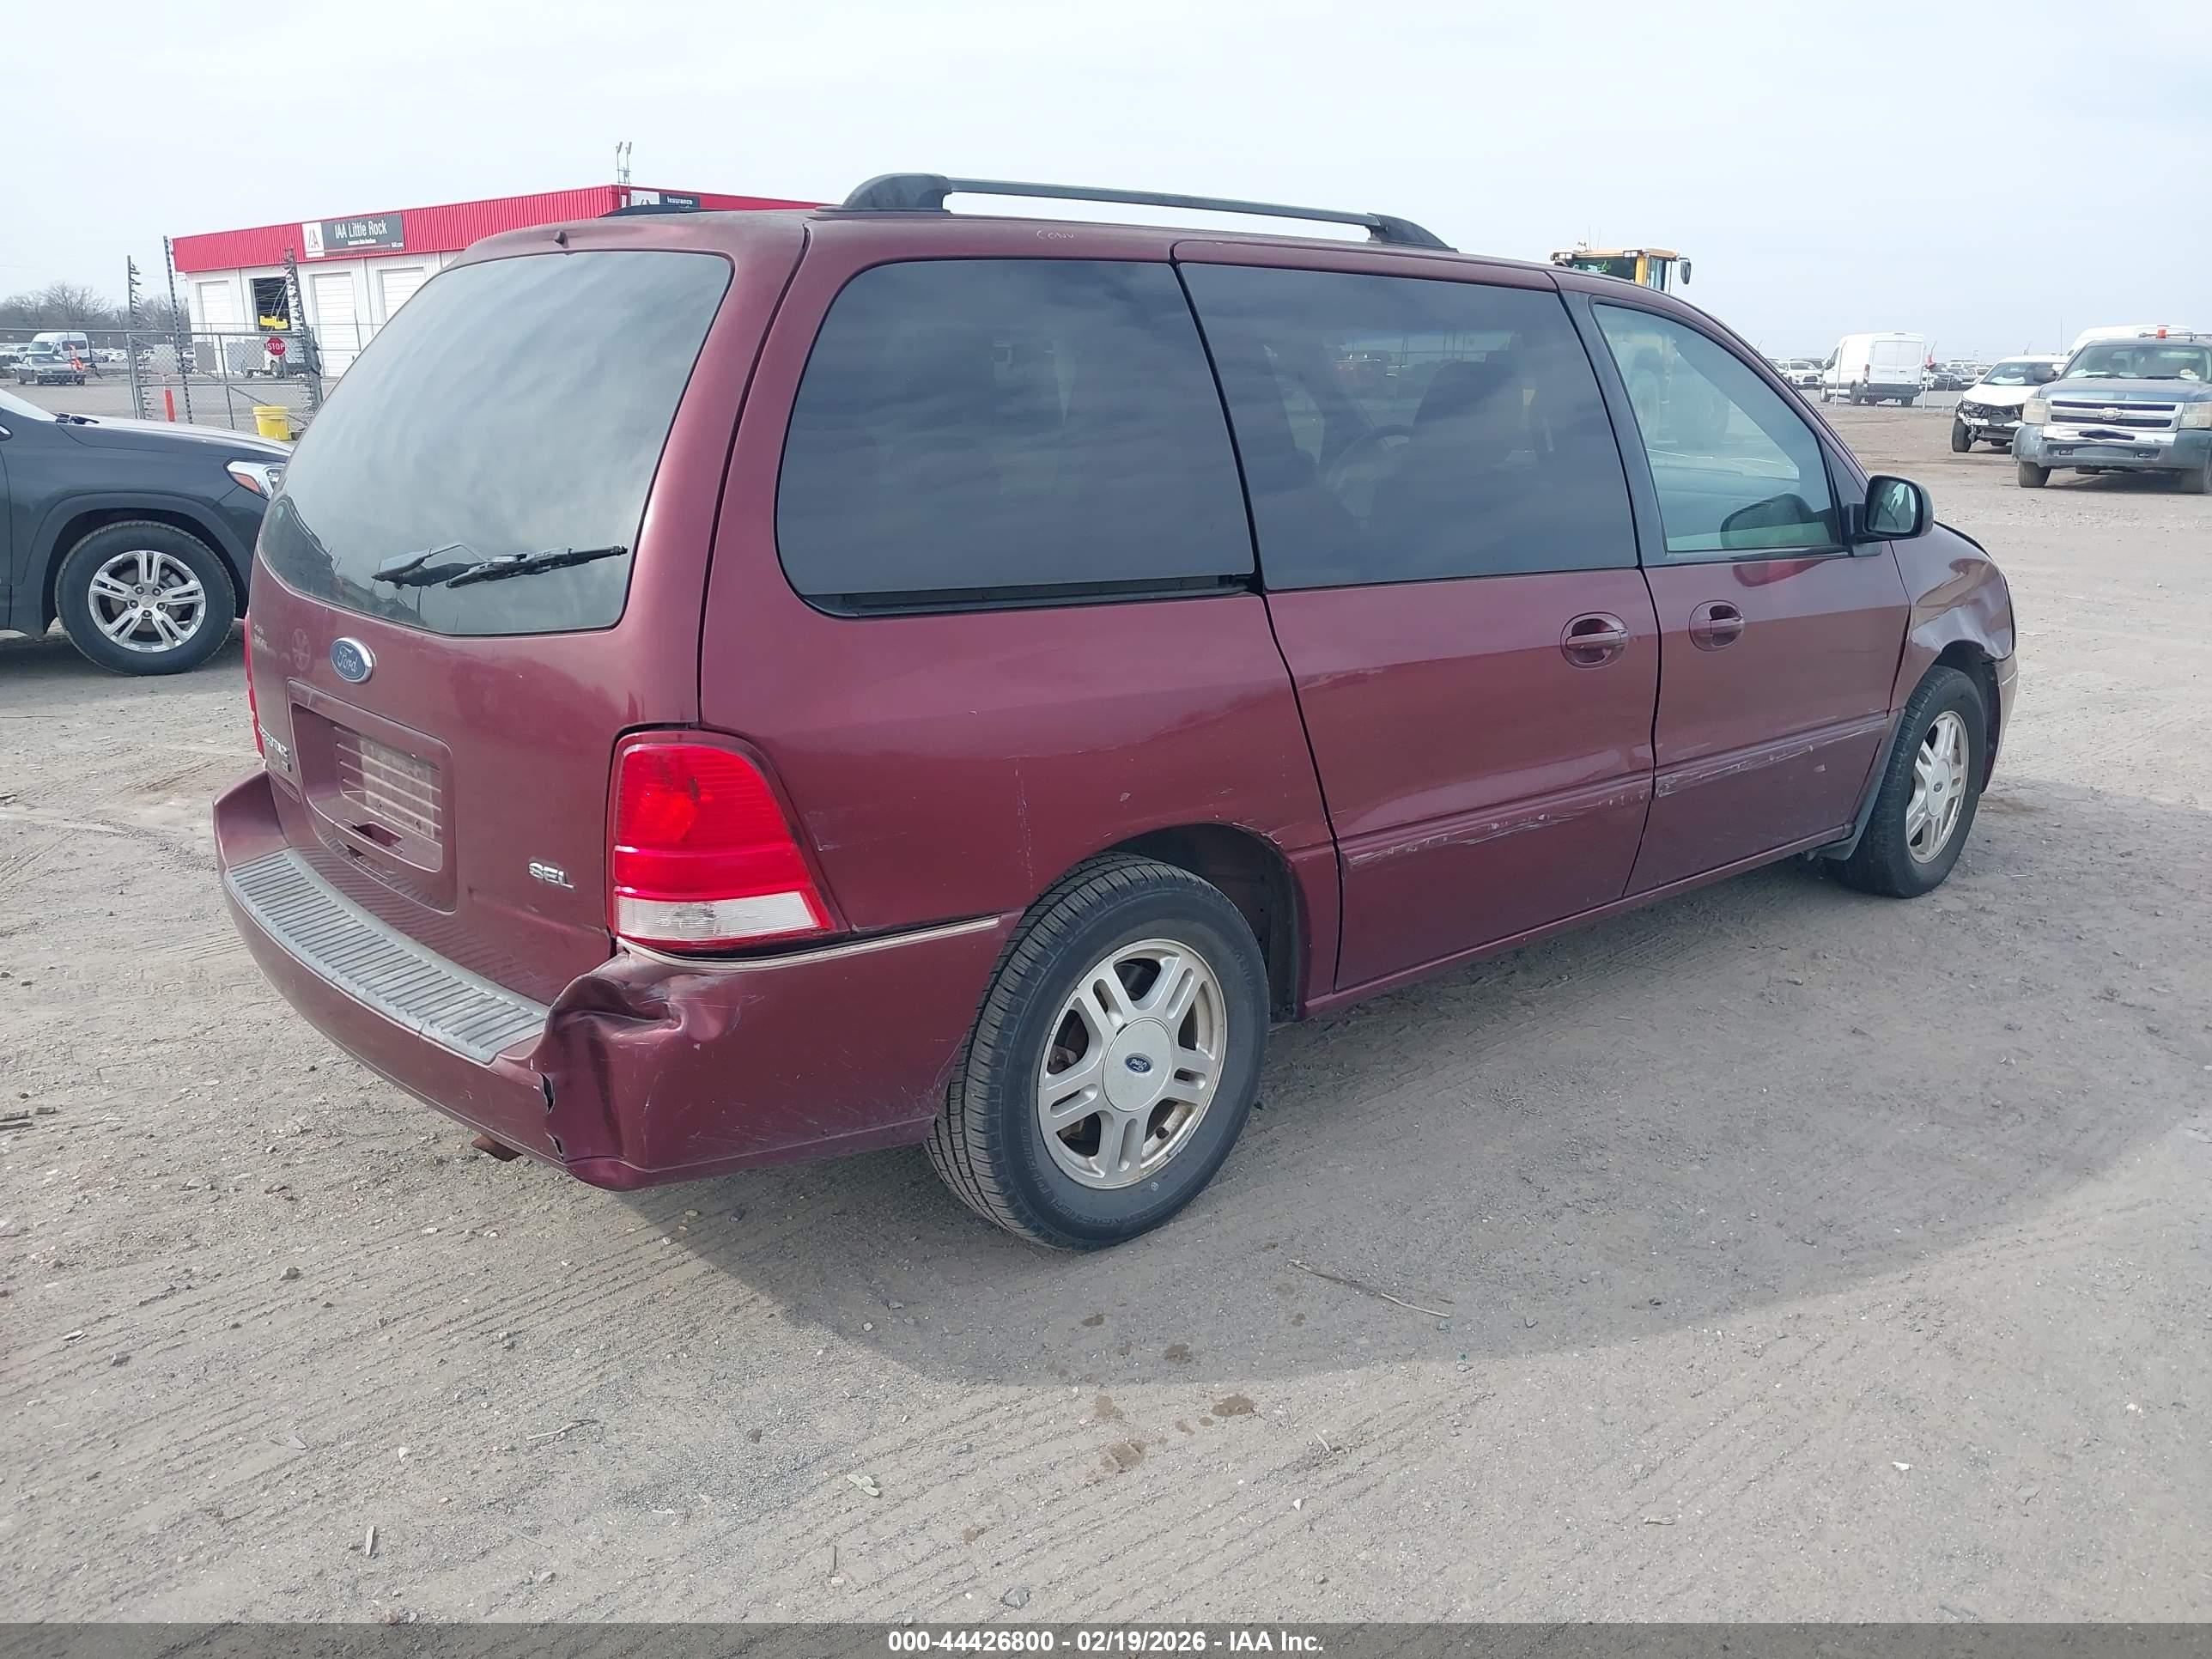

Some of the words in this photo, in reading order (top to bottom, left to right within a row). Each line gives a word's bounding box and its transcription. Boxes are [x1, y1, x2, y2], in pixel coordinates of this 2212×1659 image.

[666, 196, 693, 205] Insurance
[334, 224, 347, 240] IAA
[348, 222, 368, 238] Little
[368, 220, 388, 236] Rock
[528, 861, 574, 889] SEL
